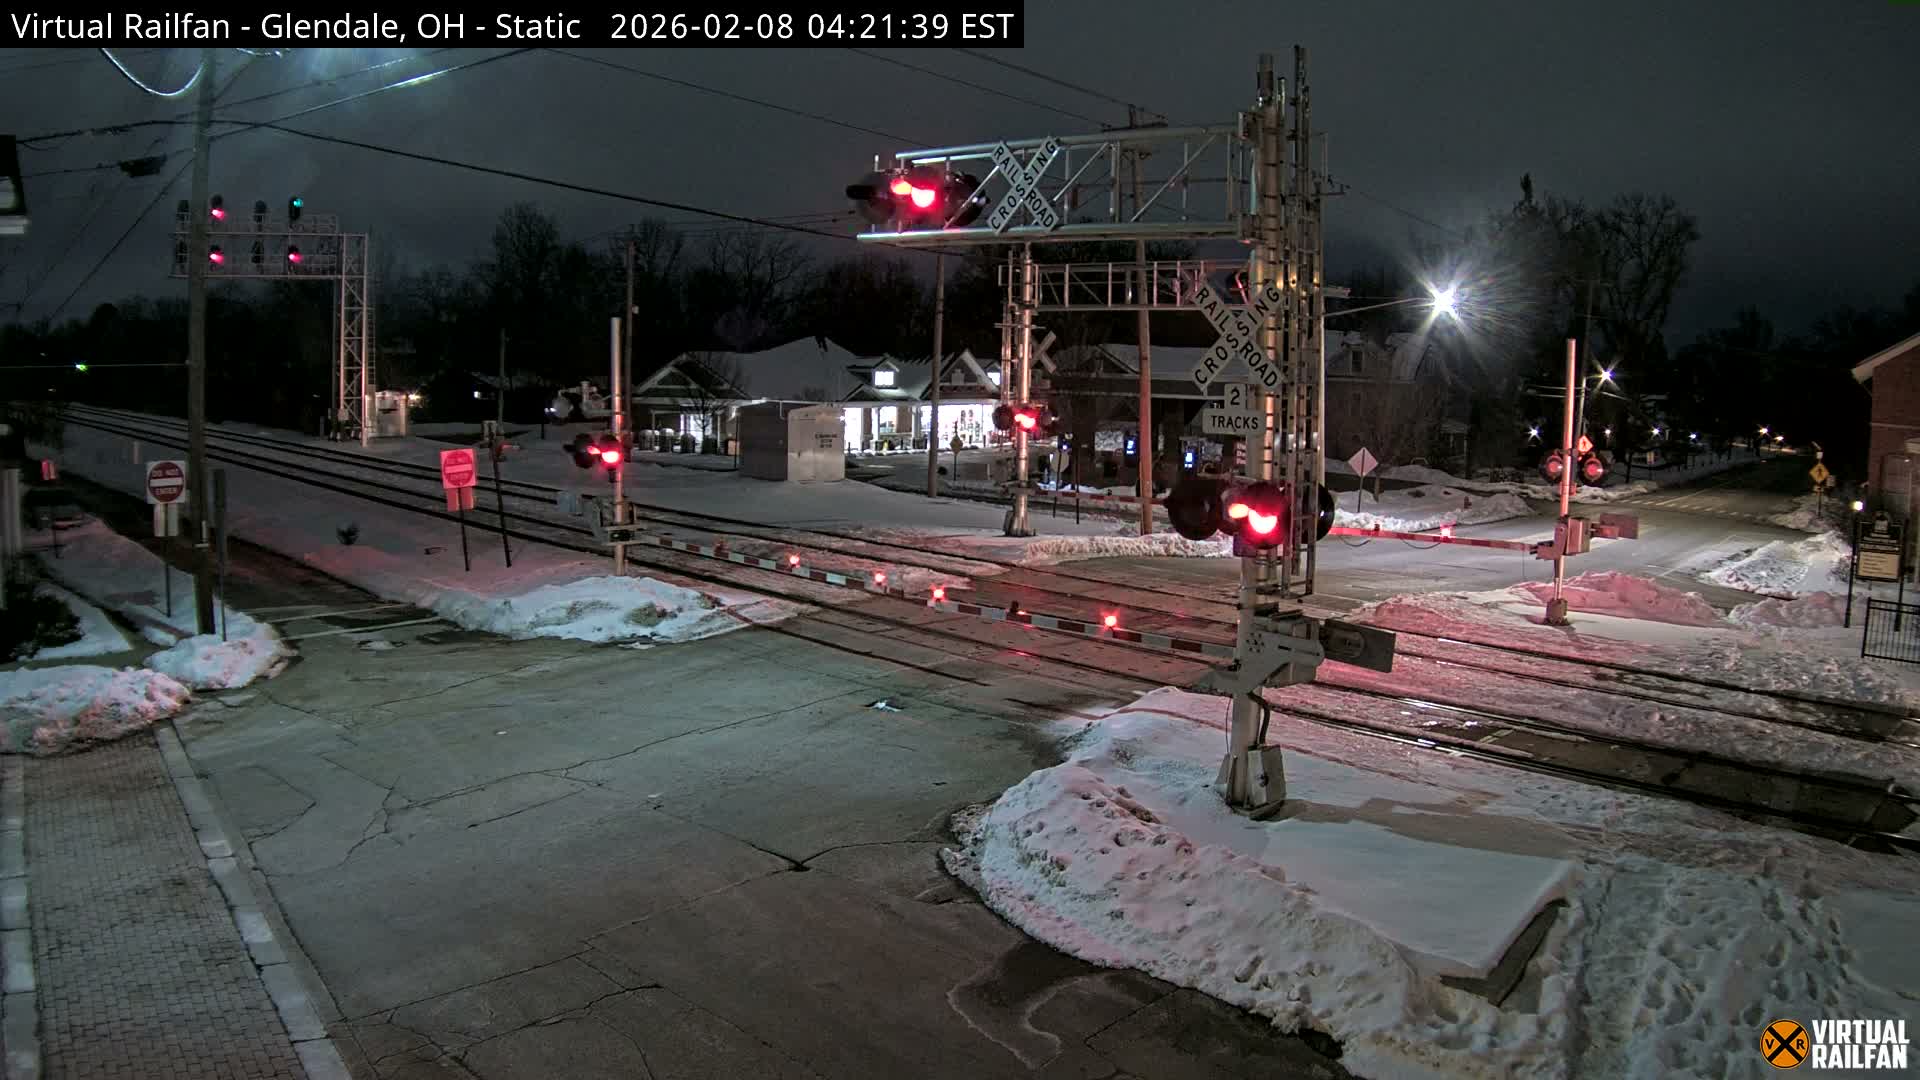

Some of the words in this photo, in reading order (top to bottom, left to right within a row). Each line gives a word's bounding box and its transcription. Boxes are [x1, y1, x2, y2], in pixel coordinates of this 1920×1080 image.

[991, 141, 1056, 230] CROSSING
[994, 146, 1055, 228] RAILROAD
[1194, 287, 1280, 385] CROSSING
[1196, 287, 1278, 388] RAILROAD
[1211, 415, 1259, 430] TRACKS
[1230, 387, 1241, 406] 2
